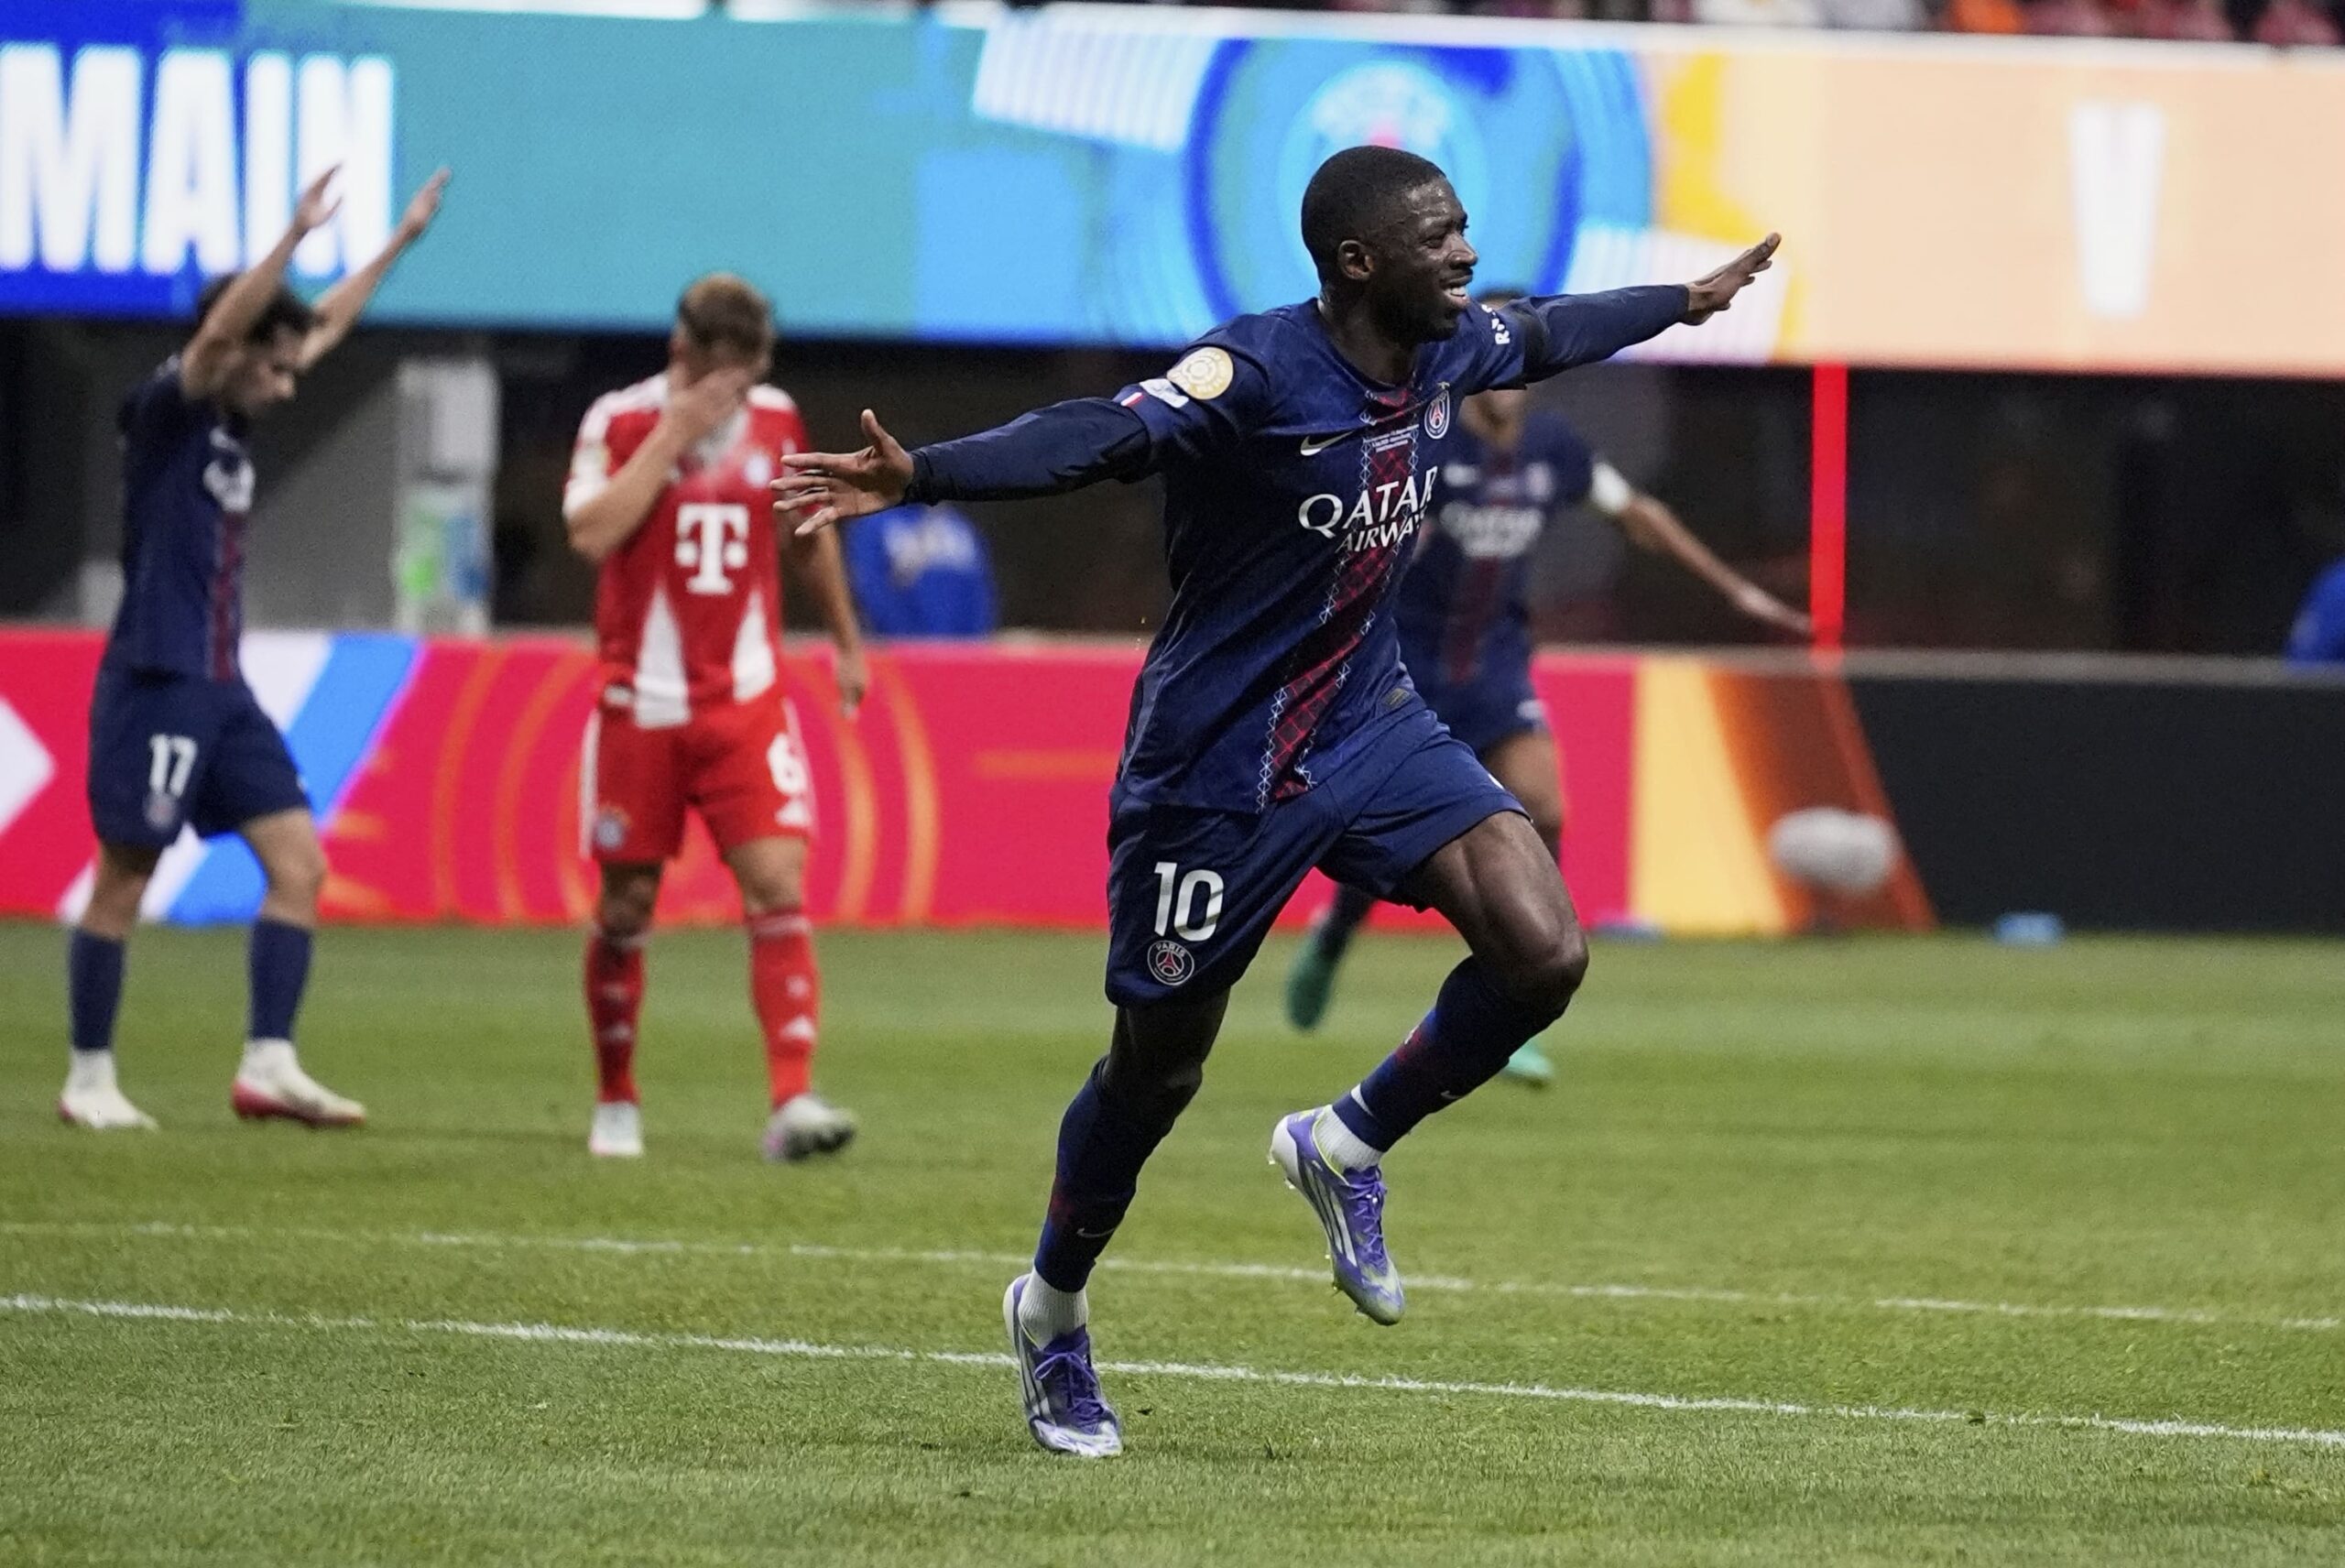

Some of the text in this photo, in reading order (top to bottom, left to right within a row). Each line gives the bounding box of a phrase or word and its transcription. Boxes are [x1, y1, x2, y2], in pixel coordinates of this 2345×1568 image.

[0, 42, 394, 277] MAIN
[1298, 465, 1438, 539] QATAR
[675, 504, 748, 593] T
[149, 734, 198, 797] 17
[766, 732, 807, 794] 6
[1154, 861, 1224, 942] 10
[1156, 942, 1185, 957] PARIS
